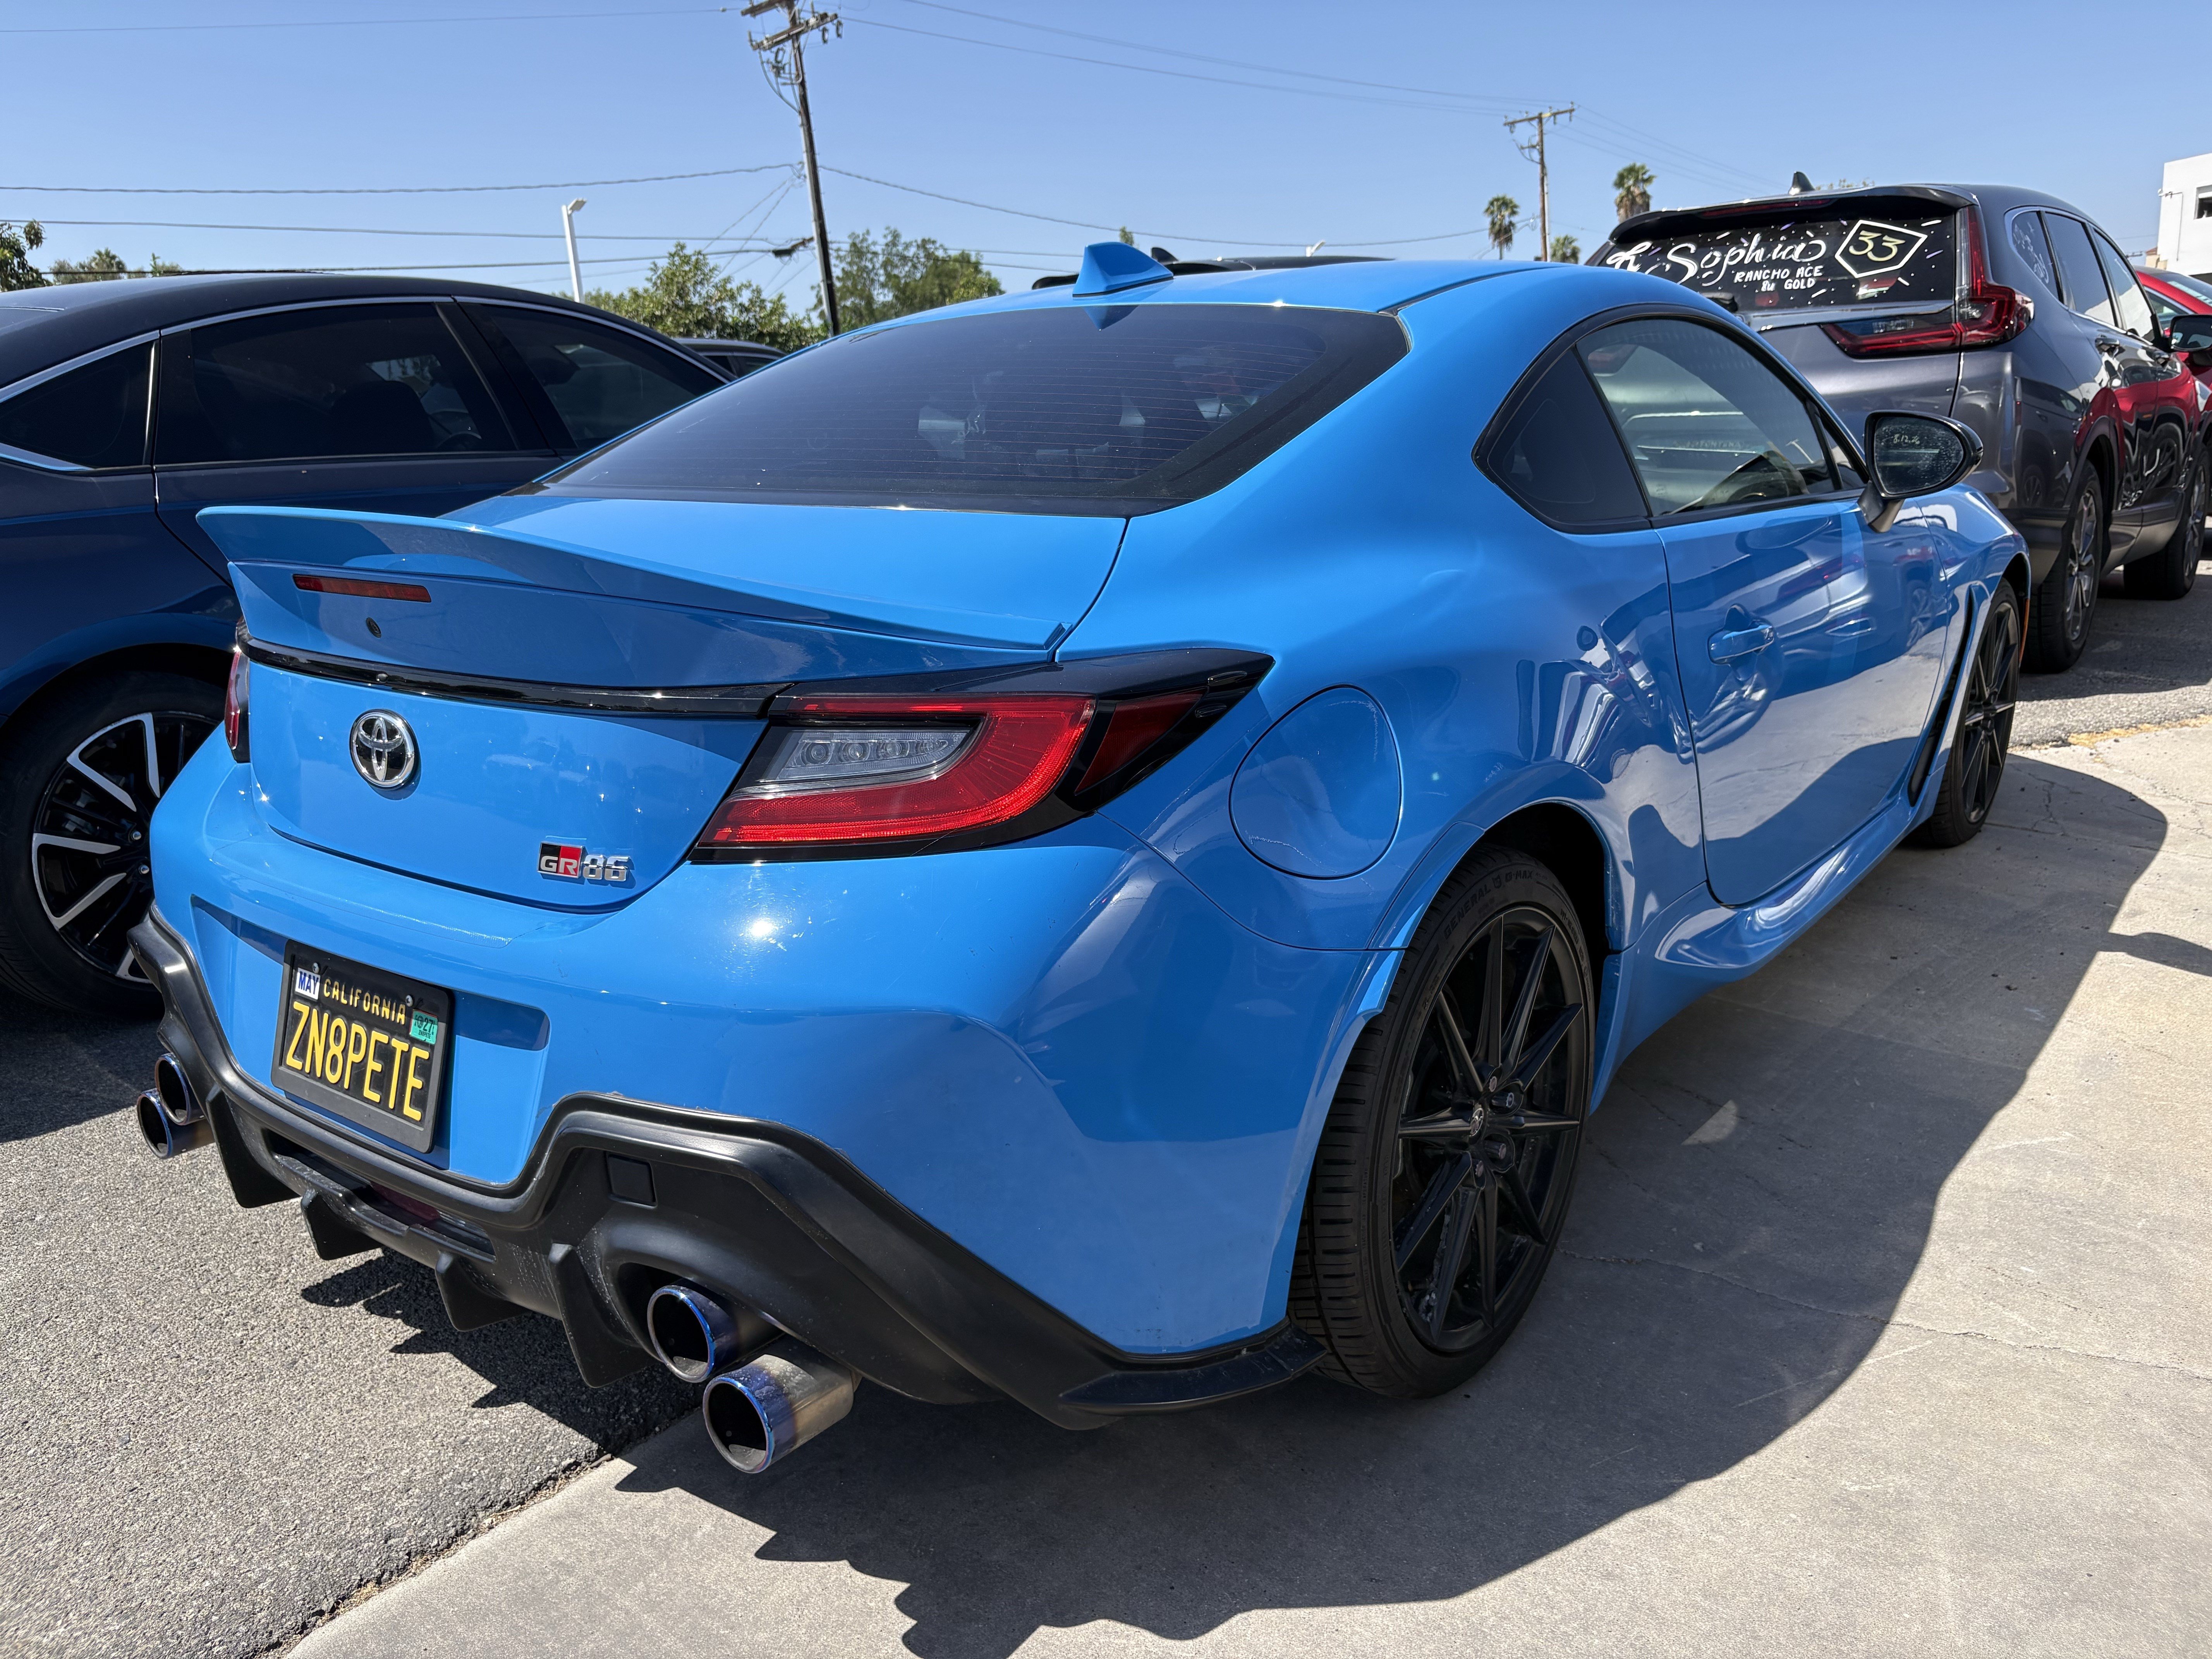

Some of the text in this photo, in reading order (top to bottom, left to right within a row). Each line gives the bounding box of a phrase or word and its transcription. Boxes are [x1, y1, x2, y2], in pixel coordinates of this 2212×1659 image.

[1848, 230, 1906, 262] 33
[1733, 265, 1824, 283] RANCHO ACE
[1784, 278, 1816, 290] GOLD
[540, 854, 630, 882] GR 86
[1443, 884, 1492, 940] GENERAL
[299, 970, 319, 994] MAY
[323, 978, 405, 1025] CALIFORNIA
[286, 1001, 430, 1121] ZN8PETE
